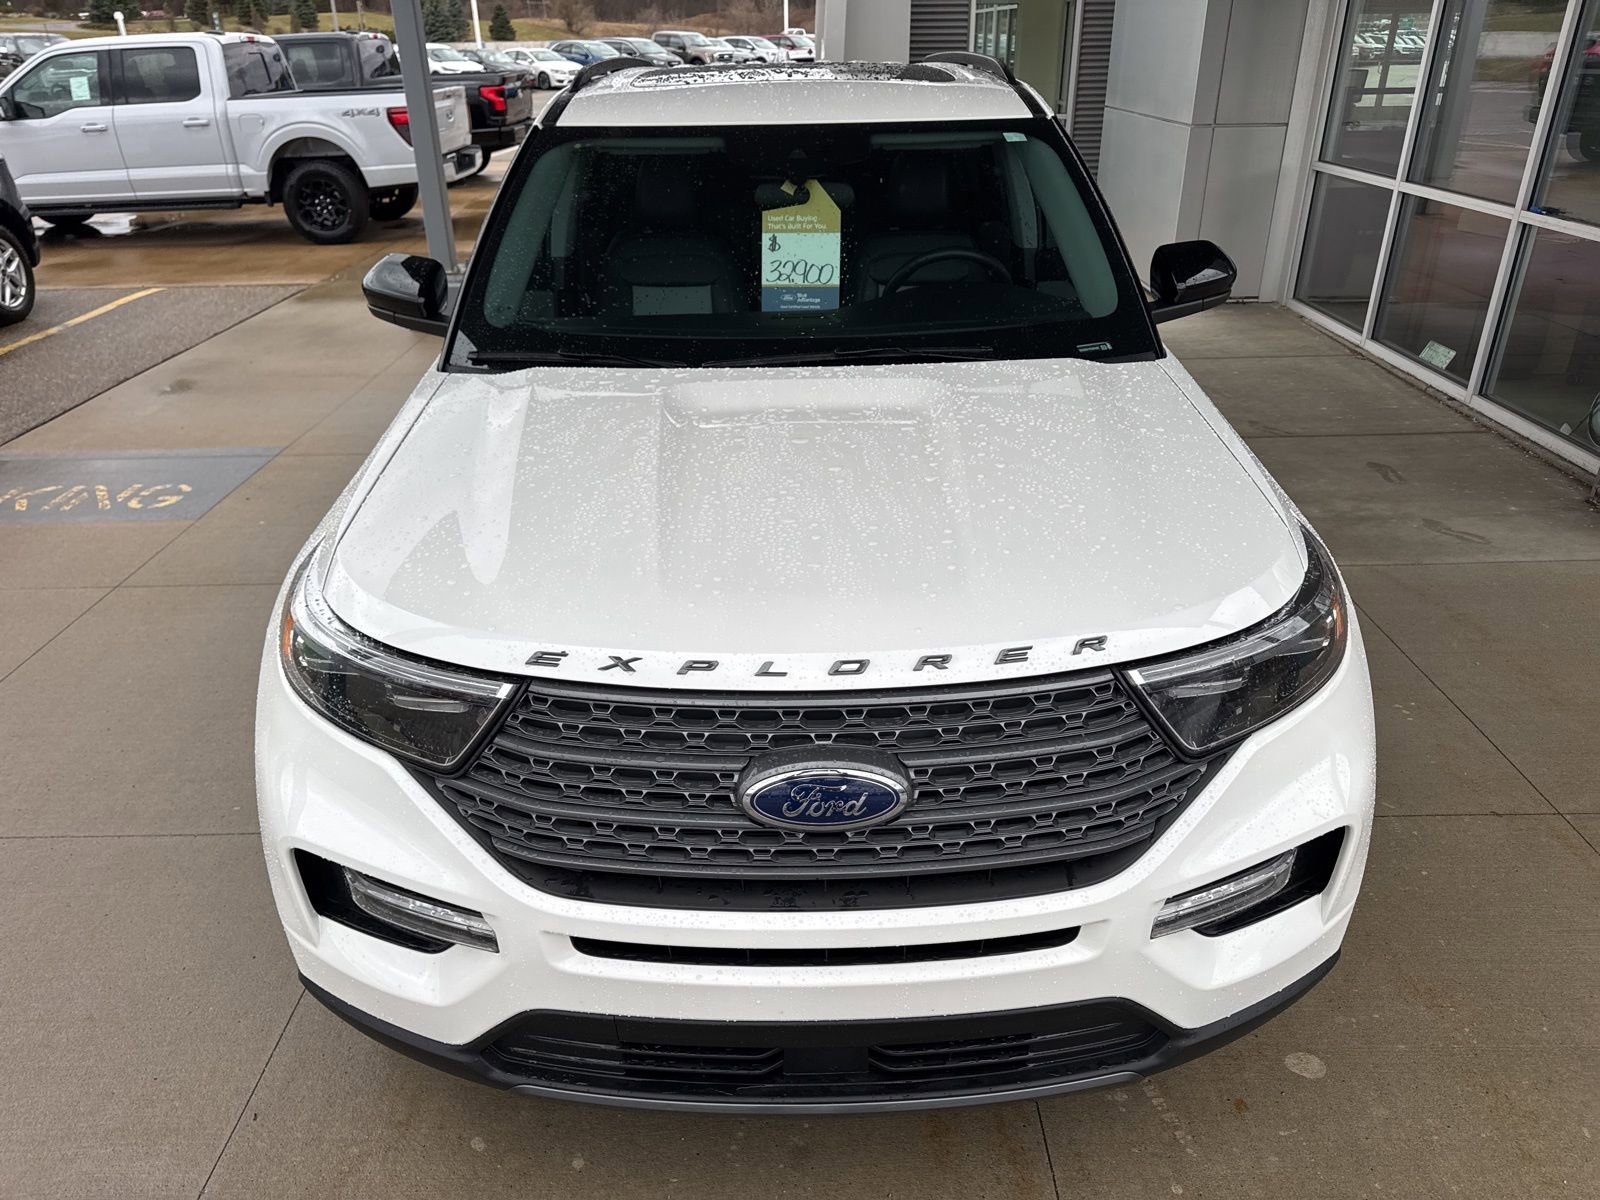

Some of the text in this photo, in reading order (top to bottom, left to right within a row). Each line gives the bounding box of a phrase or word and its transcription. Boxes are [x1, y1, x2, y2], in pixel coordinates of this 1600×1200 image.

[768, 234, 781, 252] $
[525, 635, 1109, 676] EXPLORER
[782, 783, 868, 819] Ford
